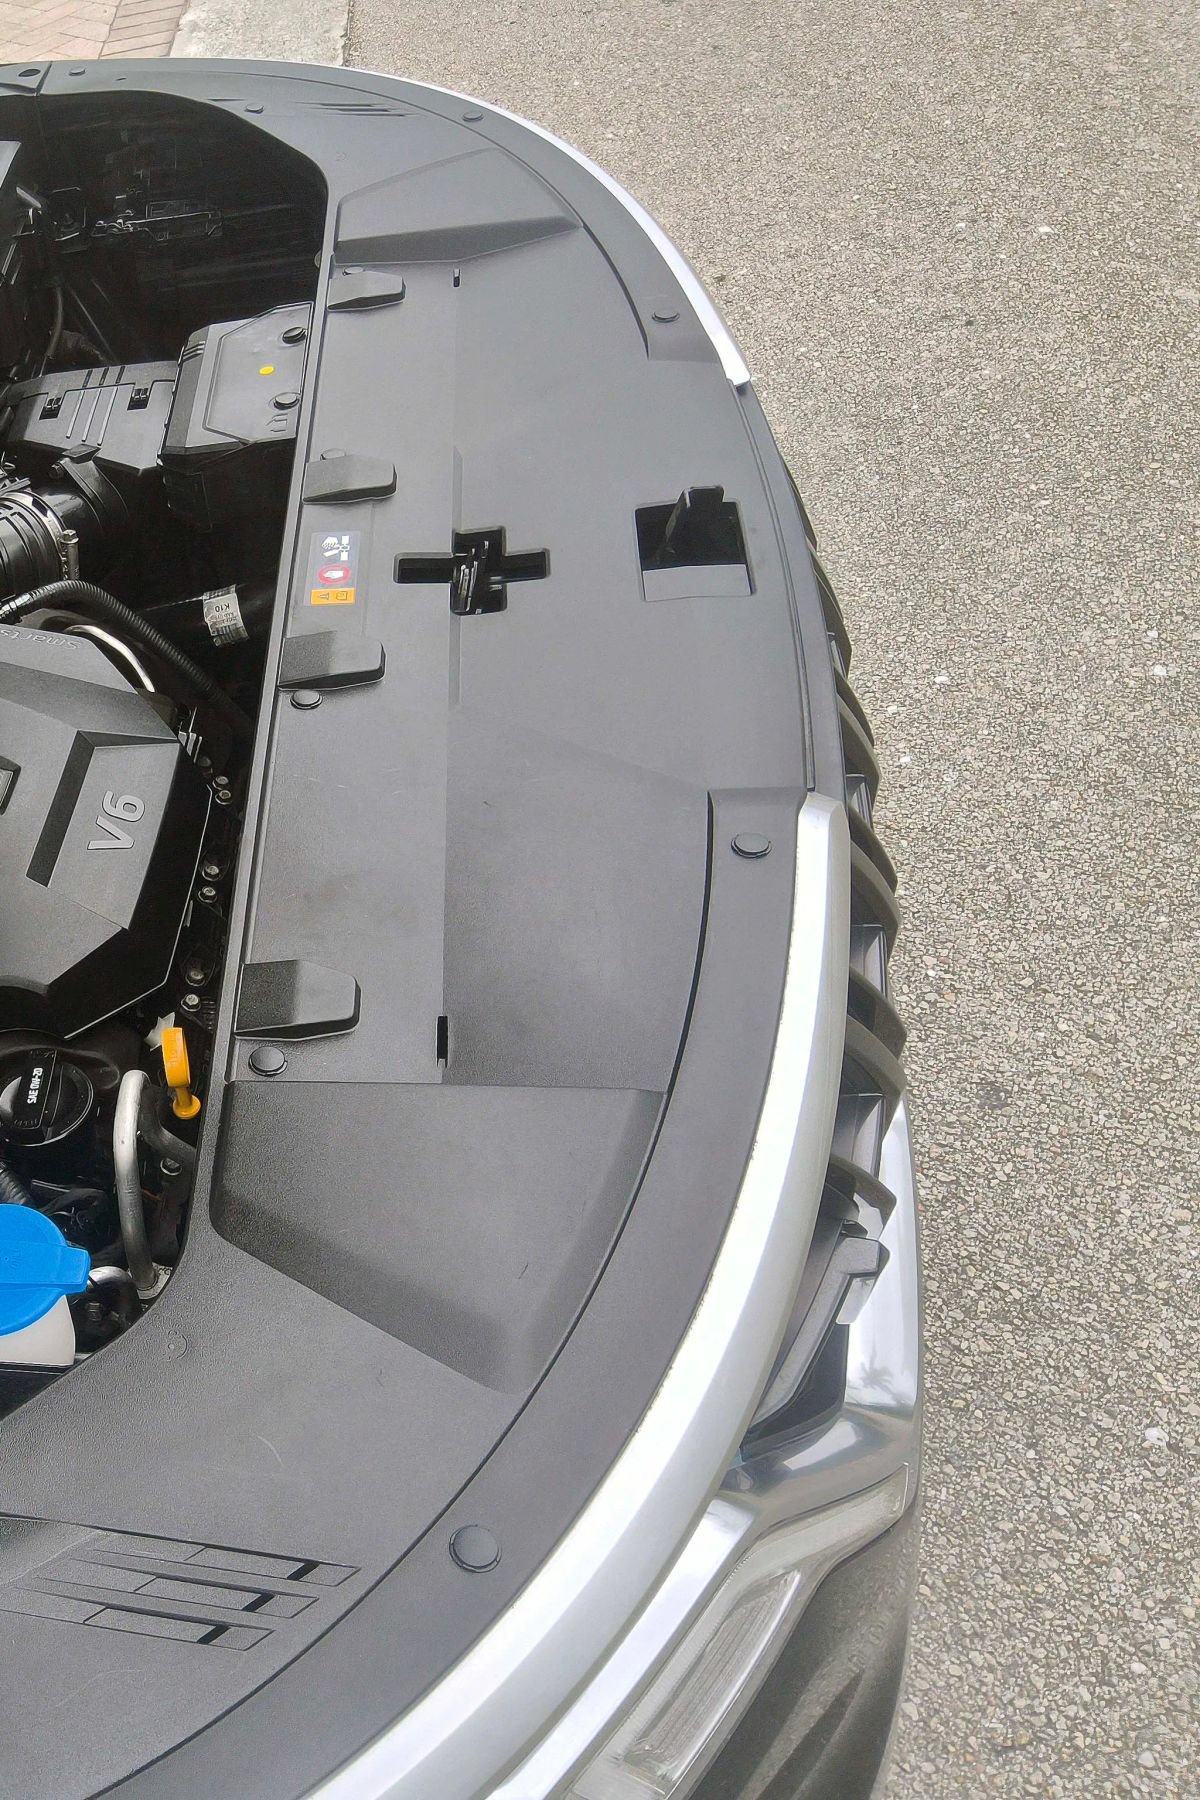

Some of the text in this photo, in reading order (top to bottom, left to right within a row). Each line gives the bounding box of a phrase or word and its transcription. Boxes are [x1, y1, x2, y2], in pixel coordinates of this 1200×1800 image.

[214, 603, 230, 612] K10
[87, 790, 145, 850] V6
[27, 1089, 39, 1104] SAE
